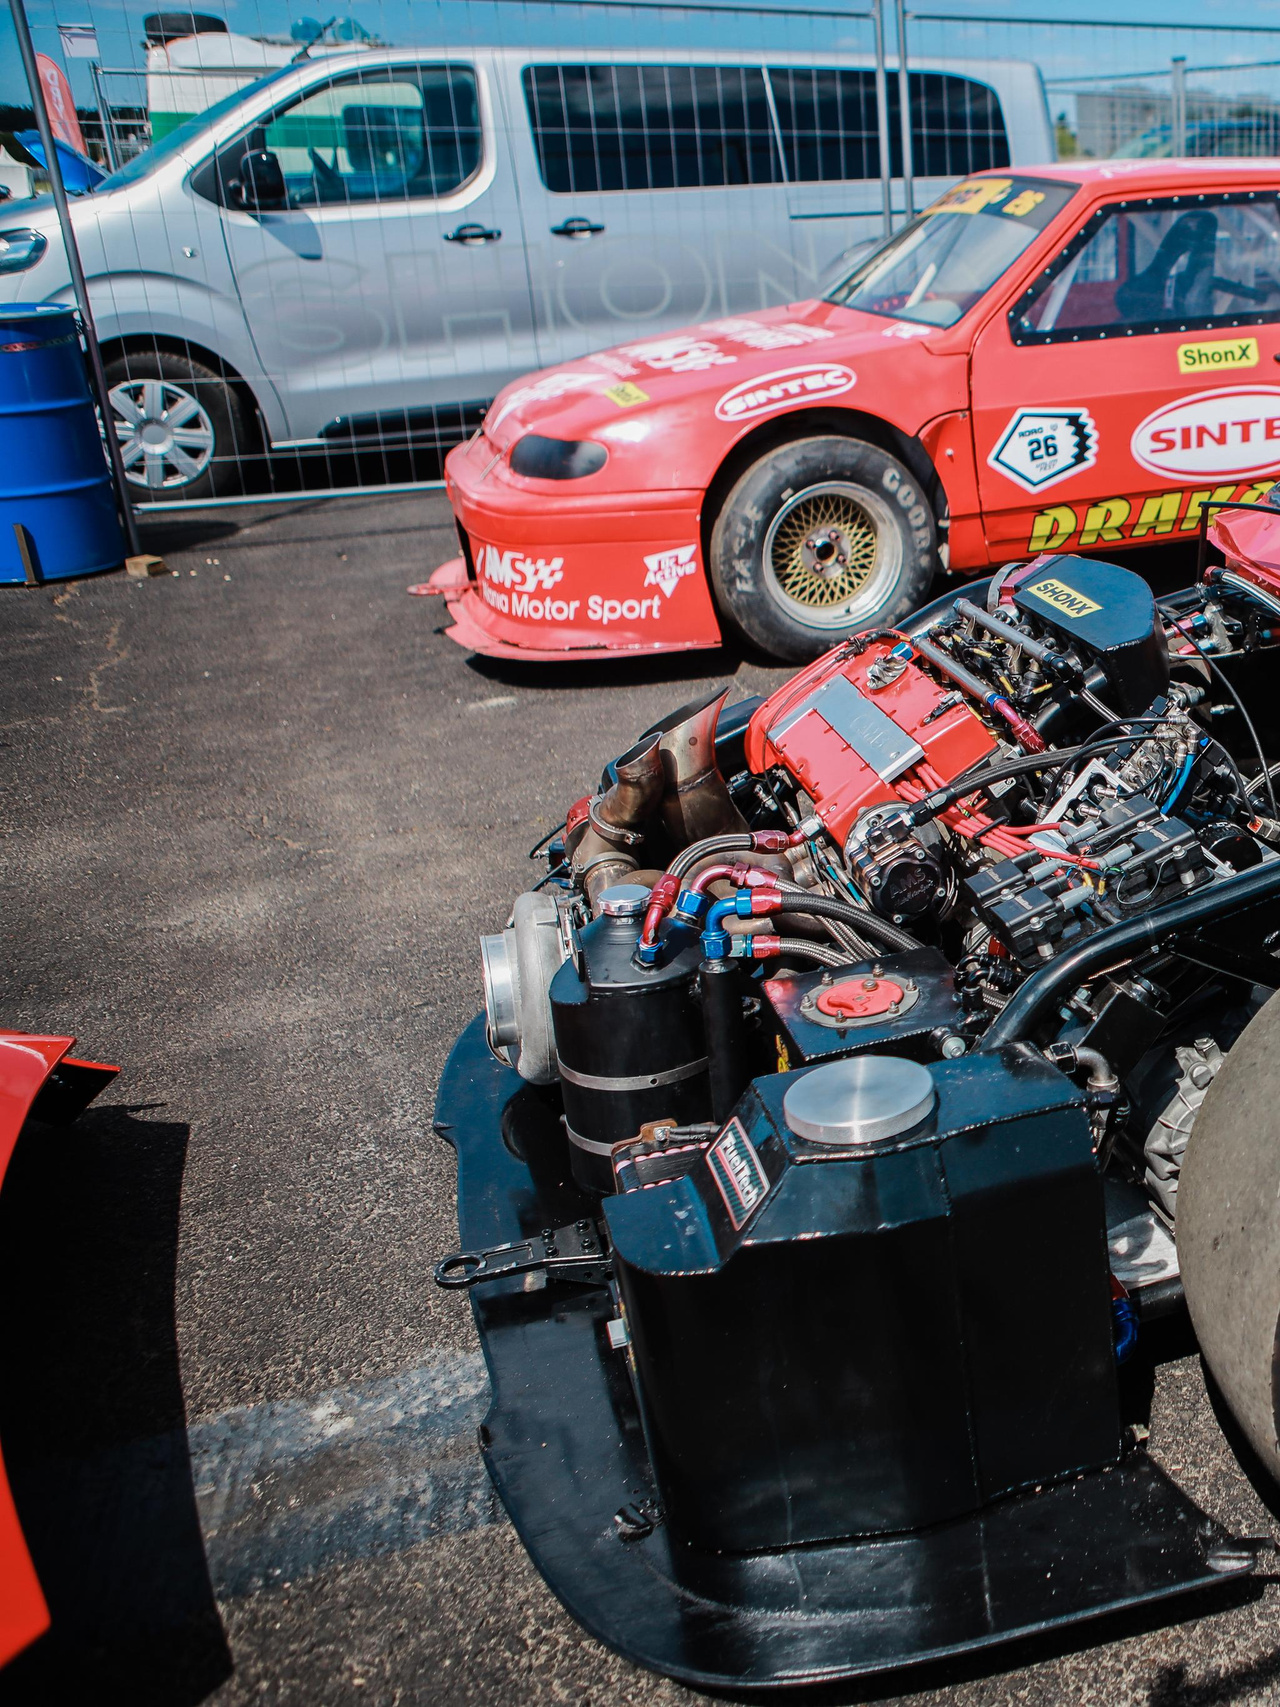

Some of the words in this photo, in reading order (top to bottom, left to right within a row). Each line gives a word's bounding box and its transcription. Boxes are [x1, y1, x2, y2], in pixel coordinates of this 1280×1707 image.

[1183, 344, 1251, 366] ShonX
[723, 370, 849, 416] SINTEC
[1028, 434, 1058, 462] 26
[643, 561, 697, 588] Active
[512, 592, 580, 621] Motor
[587, 594, 662, 626] Sport
[1036, 582, 1093, 615] SHONX
[720, 1130, 760, 1210] FuelTech
